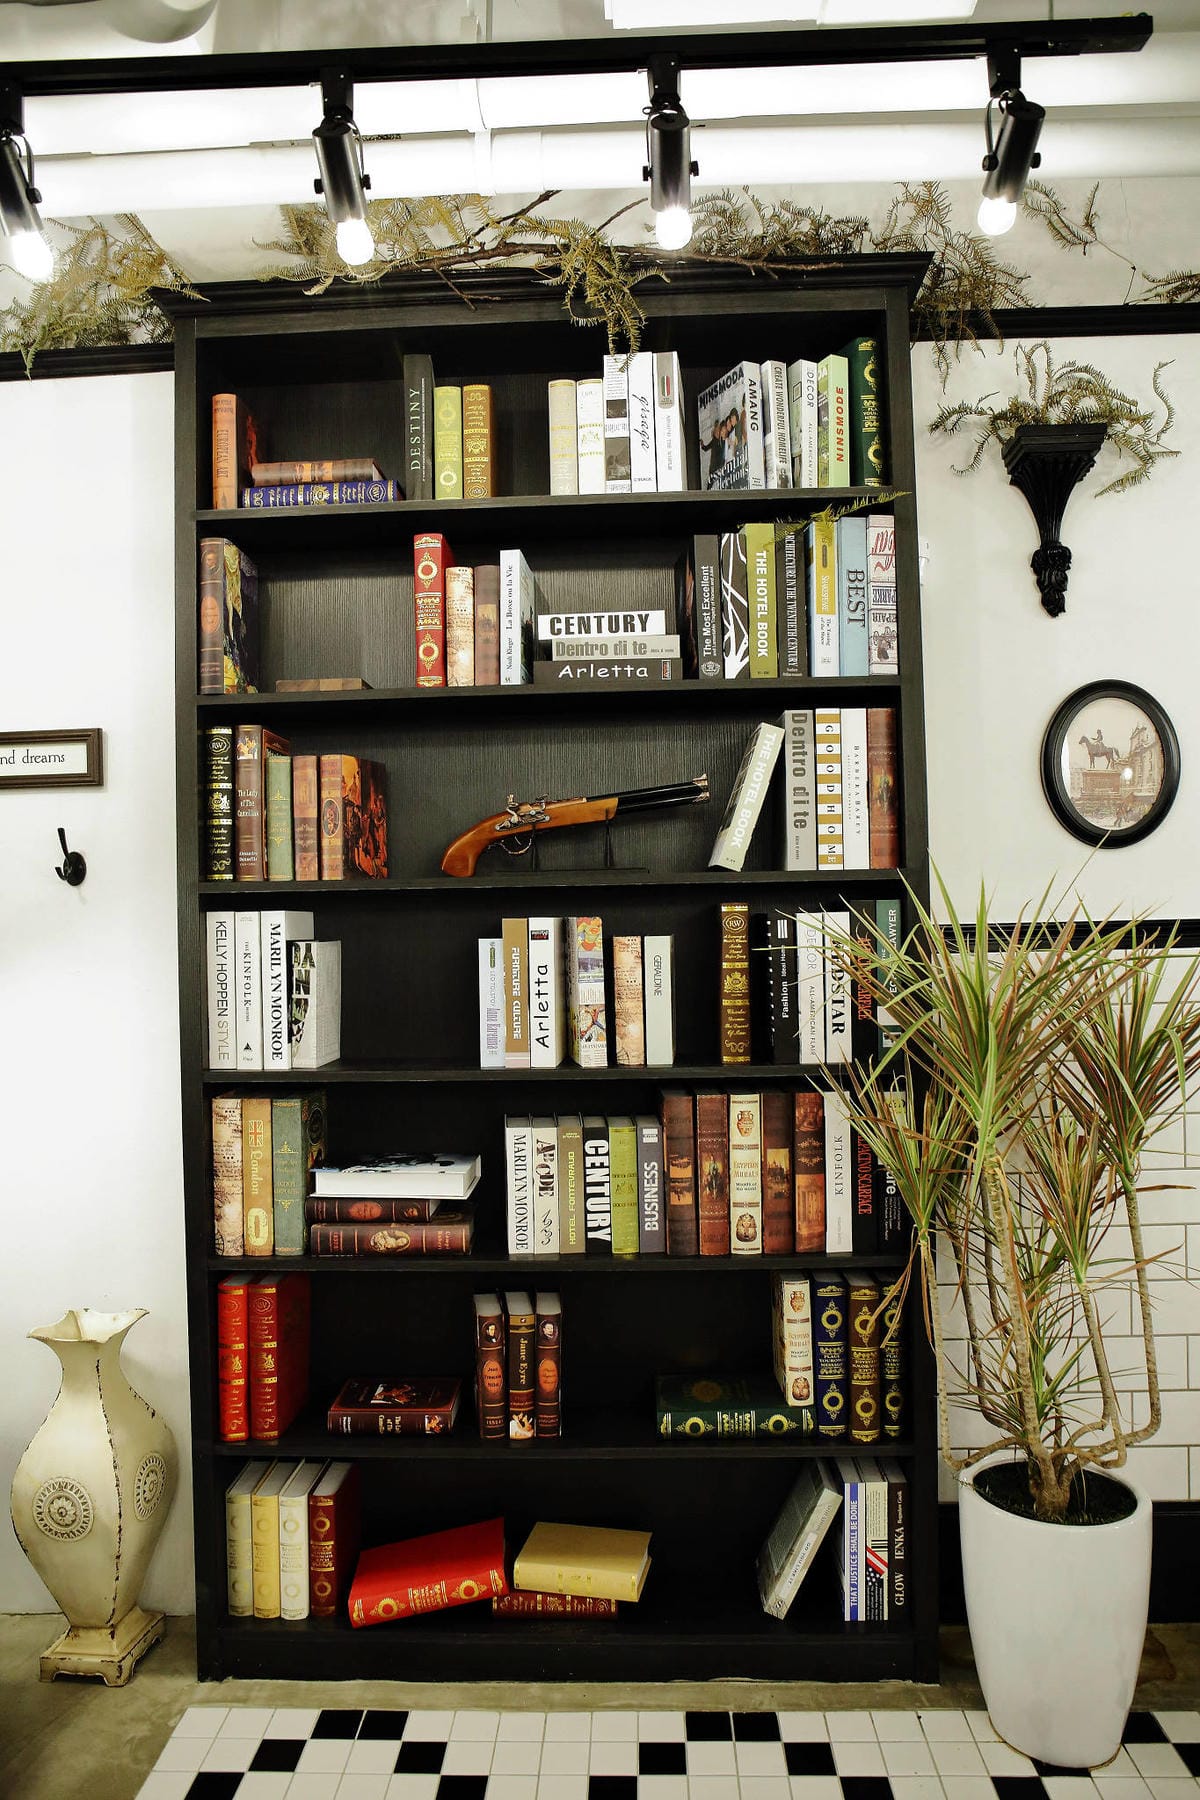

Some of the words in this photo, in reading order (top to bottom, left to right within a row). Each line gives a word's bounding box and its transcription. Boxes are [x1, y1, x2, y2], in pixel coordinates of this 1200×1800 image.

[774, 366, 784, 389] CREATE
[806, 372, 814, 408] DECOR
[748, 379, 759, 432] AMANG
[776, 392, 786, 430] WONDERFUL
[836, 386, 844, 462] NINSMODE
[410, 388, 420, 470] DESTINY
[777, 432, 788, 464] HOMELIFE
[756, 551, 766, 575] THE
[701, 566, 710, 610] Excellent
[756, 578, 767, 619] HOTEL
[786, 588, 797, 599] THE
[847, 569, 865, 627] BEST
[506, 619, 513, 630] La
[550, 613, 650, 636] CENTURY
[702, 612, 711, 636] Most
[786, 600, 798, 636] TWENTIETH
[556, 640, 608, 657] Dentro
[614, 638, 630, 656] di
[632, 638, 648, 656] te
[703, 639, 712, 656] The
[757, 622, 768, 657] BOOK
[787, 638, 798, 667] CENTURY
[558, 664, 648, 680] Arletta
[22, 748, 65, 764] dreams
[760, 732, 777, 760] THE
[792, 713, 808, 777] Dentro
[746, 759, 768, 806] HOTEL
[792, 786, 810, 804] di
[732, 809, 752, 848] BOOK
[794, 810, 810, 829] te
[215, 920, 227, 960] KELLY
[270, 923, 281, 993] MARILYN
[804, 928, 816, 969] DECOR
[216, 964, 228, 1016] HOPPEN
[244, 952, 252, 1006] KINFOLK
[512, 947, 520, 996] FURNITURE
[653, 954, 662, 996] GERALDINE
[512, 1000, 522, 1040] CULTURE
[534, 964, 550, 1048] Arletta
[218, 1020, 229, 1061] STYLE
[272, 996, 283, 1060] MONROE
[250, 1151, 263, 1194] London
[514, 1134, 526, 1192] MARILYN
[536, 1139, 556, 1197] ABCDE
[835, 1135, 844, 1195] KINFOLK
[858, 1144, 872, 1173] PACINO
[584, 1140, 612, 1241] CENTURY
[644, 1162, 659, 1231] BUSINESS
[858, 1174, 872, 1215] SCARFACE
[515, 1195, 528, 1250] MONROE
[850, 1500, 858, 1520] DONE
[850, 1521, 858, 1530] BE
[850, 1530, 858, 1552] SHALL
[850, 1554, 858, 1585] JUSTICE
[894, 1572, 904, 1606] GLOW
[850, 1586, 858, 1607] THAT
